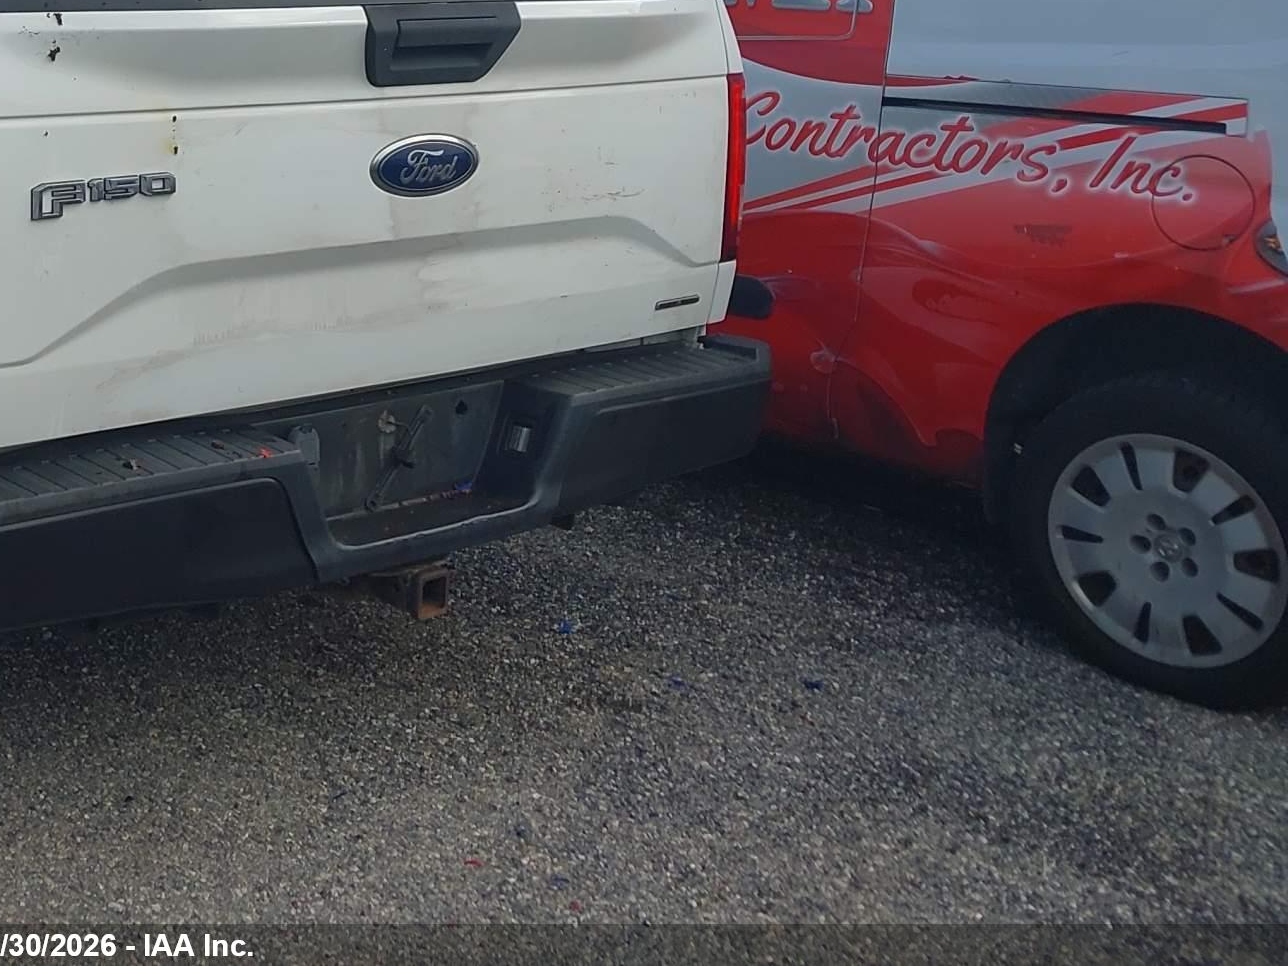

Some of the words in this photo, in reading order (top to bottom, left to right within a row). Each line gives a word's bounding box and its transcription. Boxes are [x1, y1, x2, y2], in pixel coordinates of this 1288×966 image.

[399, 149, 459, 185] Ford
[745, 91, 1069, 193] Contractors,
[1088, 135, 1194, 202] Inc.
